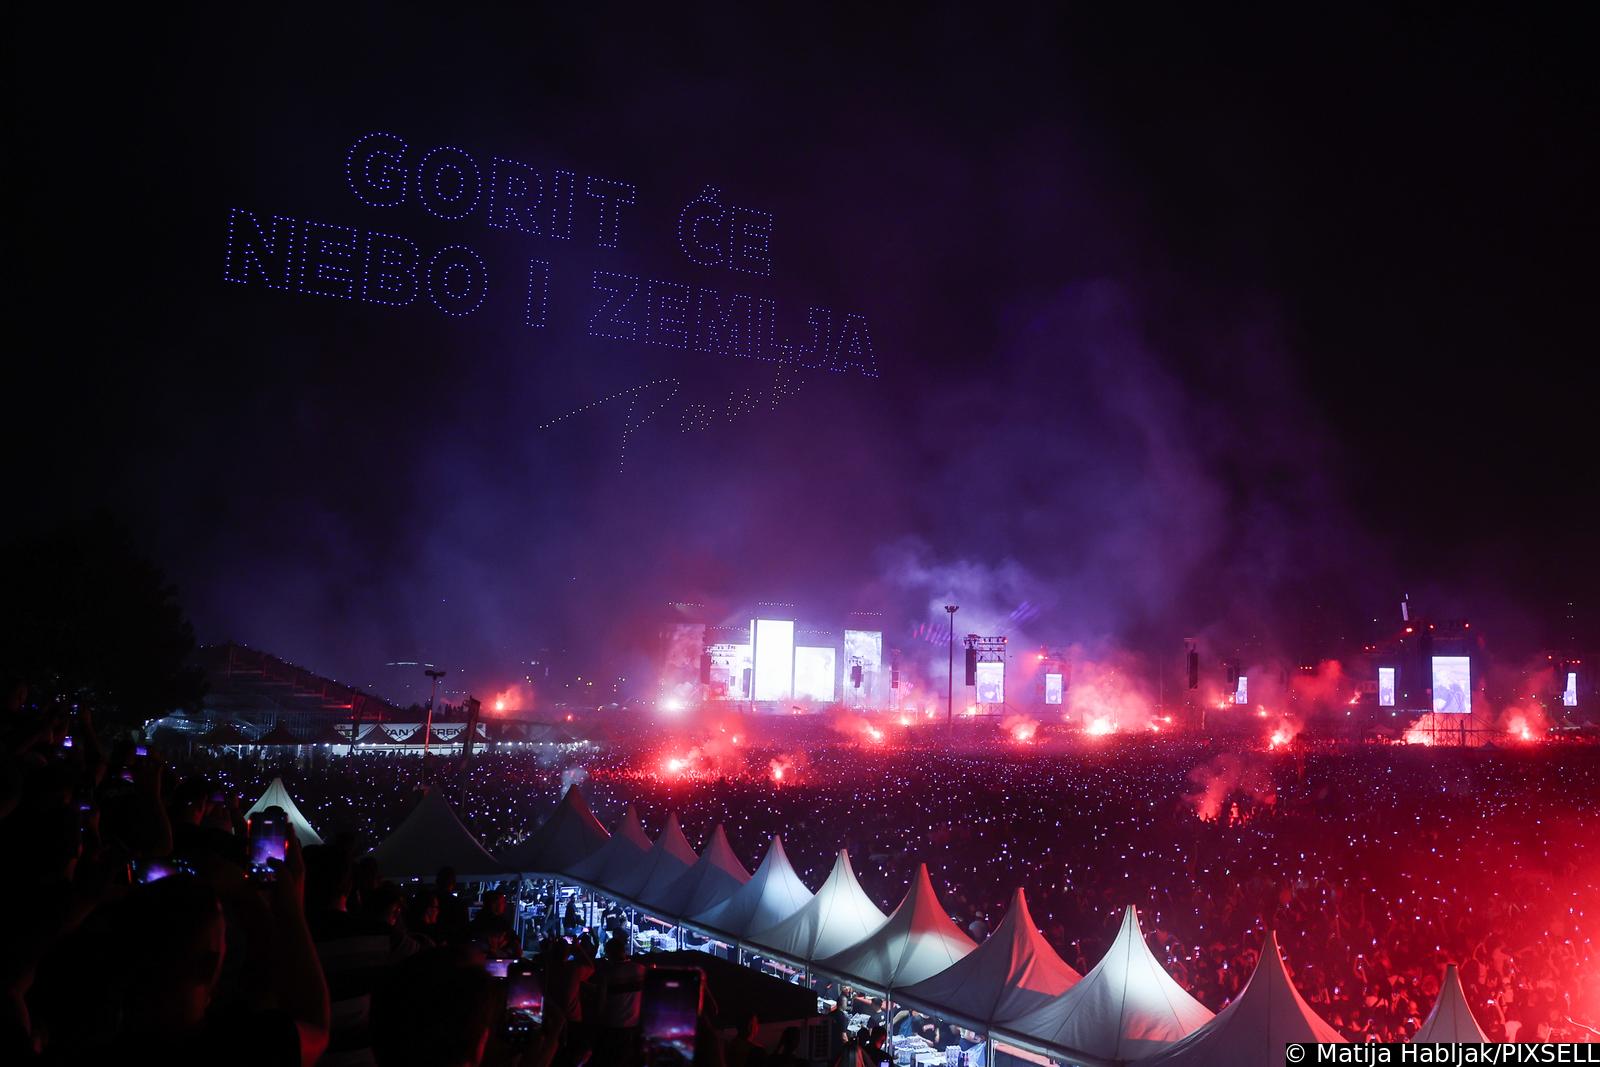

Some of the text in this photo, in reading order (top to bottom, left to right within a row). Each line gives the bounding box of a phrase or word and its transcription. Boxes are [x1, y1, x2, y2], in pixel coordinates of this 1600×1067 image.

[346, 132, 772, 276] GORIT ĆE
[224, 208, 880, 378] NEBO I ZEMLJA
